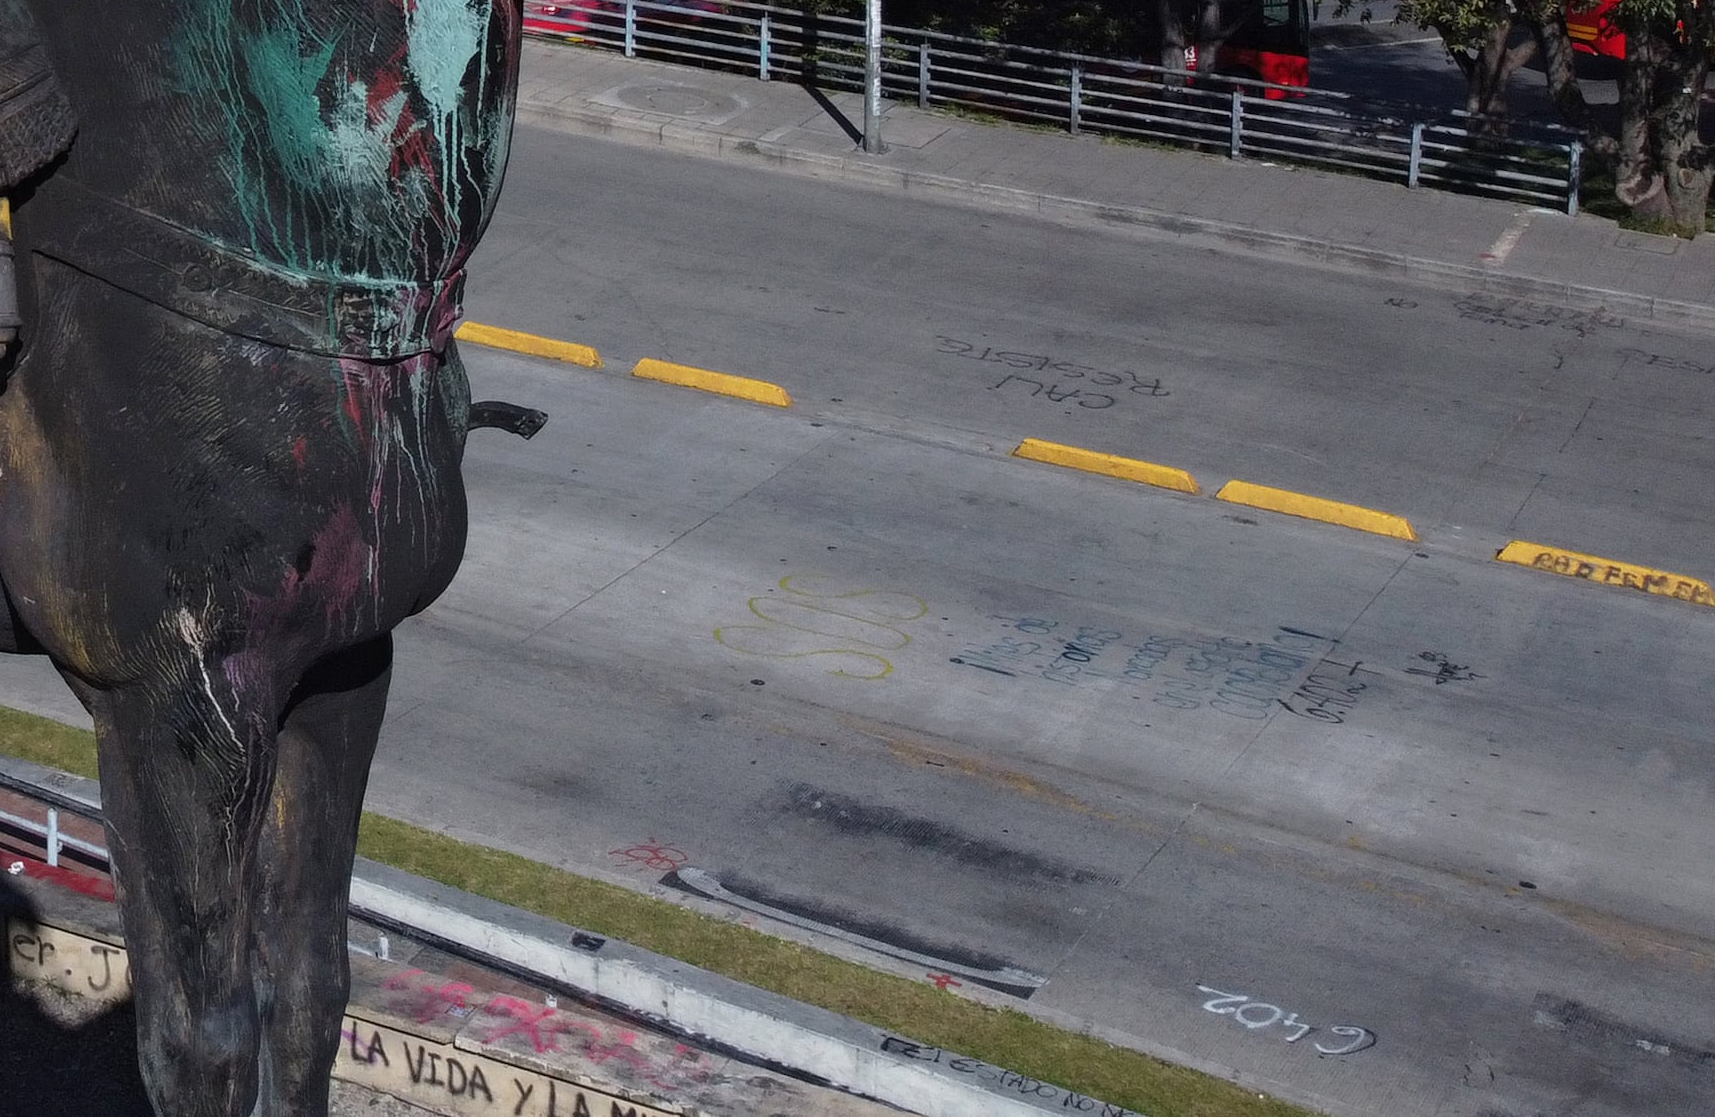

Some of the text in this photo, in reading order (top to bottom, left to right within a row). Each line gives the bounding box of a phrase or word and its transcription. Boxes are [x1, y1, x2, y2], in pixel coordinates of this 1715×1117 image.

[935, 334, 1171, 397] RESISTE
[986, 374, 1116, 410] CALI
[350, 1020, 390, 1068] LA
[403, 1041, 494, 1103] VIDA
[513, 1077, 534, 1116] Y
[949, 1057, 1059, 1099] ESTADO
[1063, 1092, 1096, 1111] NO
